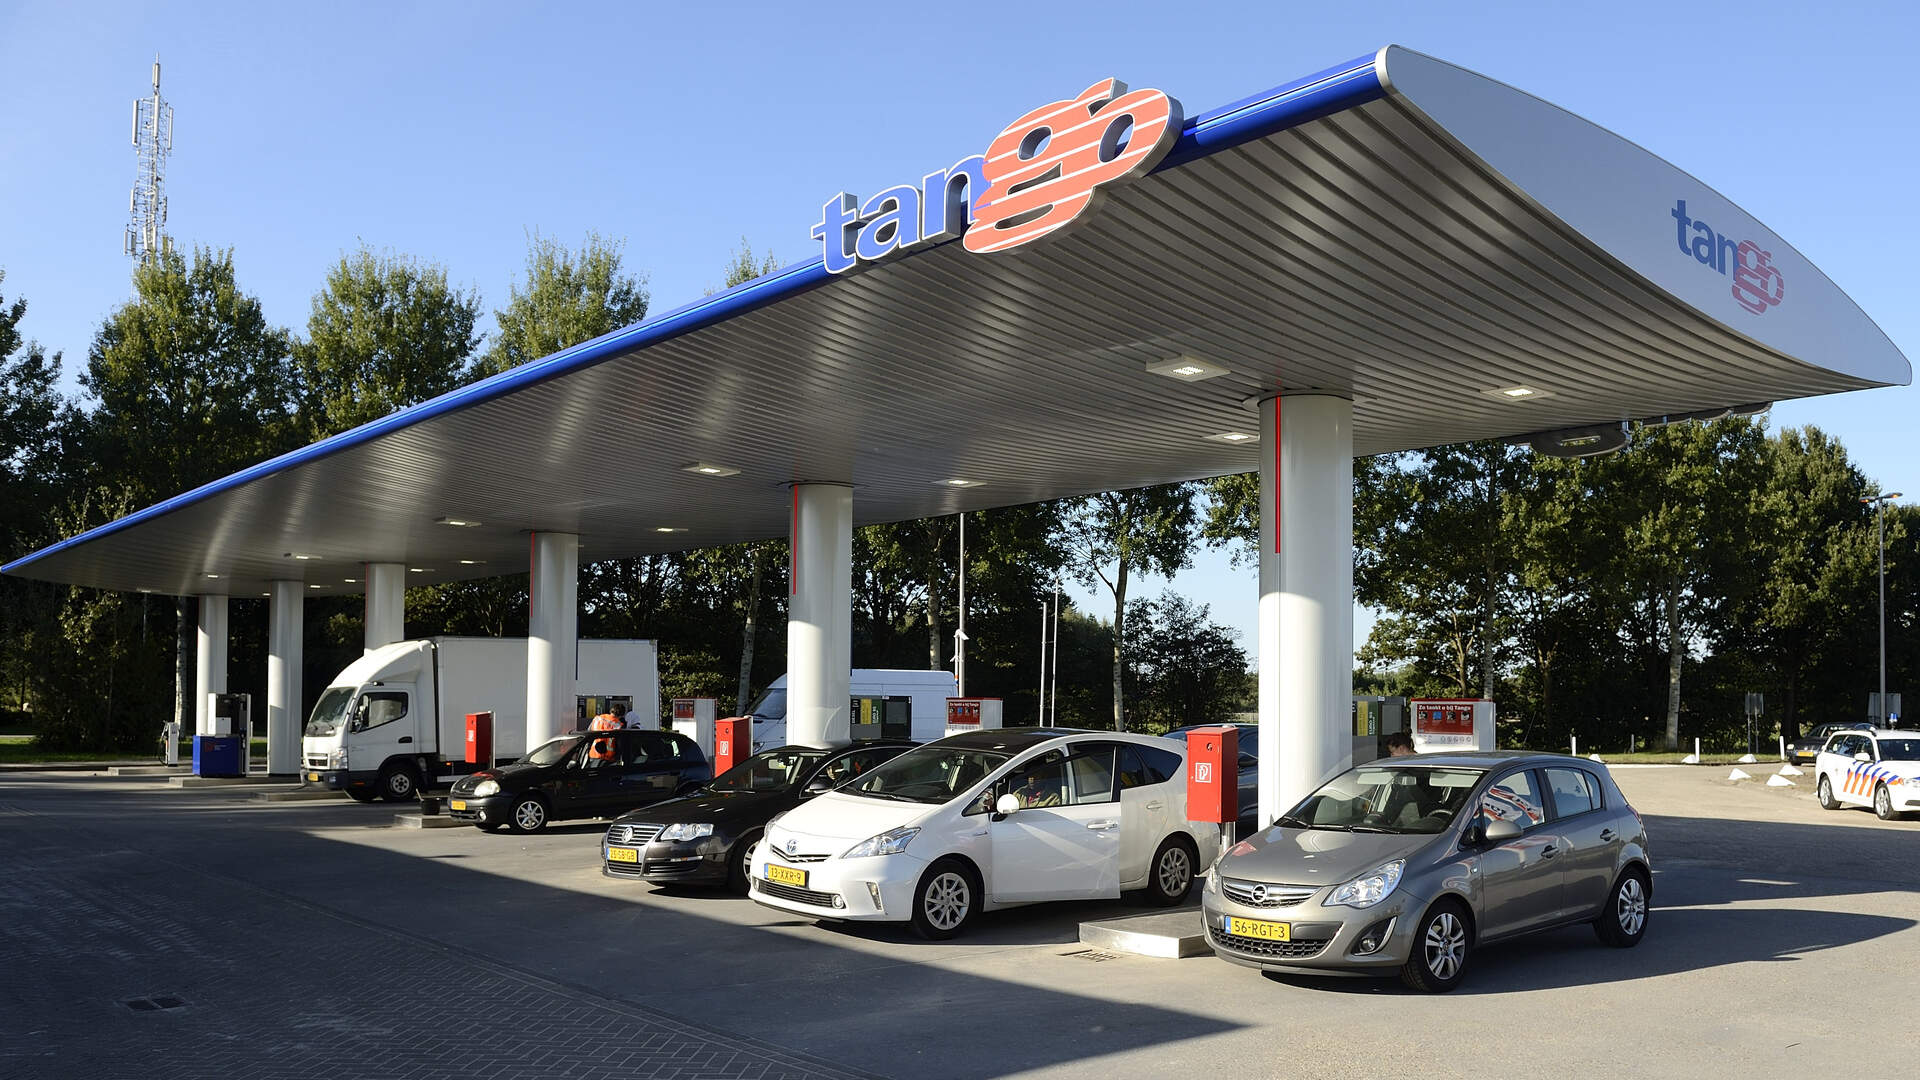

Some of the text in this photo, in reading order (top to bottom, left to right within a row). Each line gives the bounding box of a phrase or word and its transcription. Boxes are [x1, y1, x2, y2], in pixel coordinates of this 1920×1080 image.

[811, 77, 1175, 274] tango
[1671, 199, 1785, 316] tango
[770, 866, 801, 883] 13-XXR-9
[1234, 920, 1285, 939] 56-RGT-3
